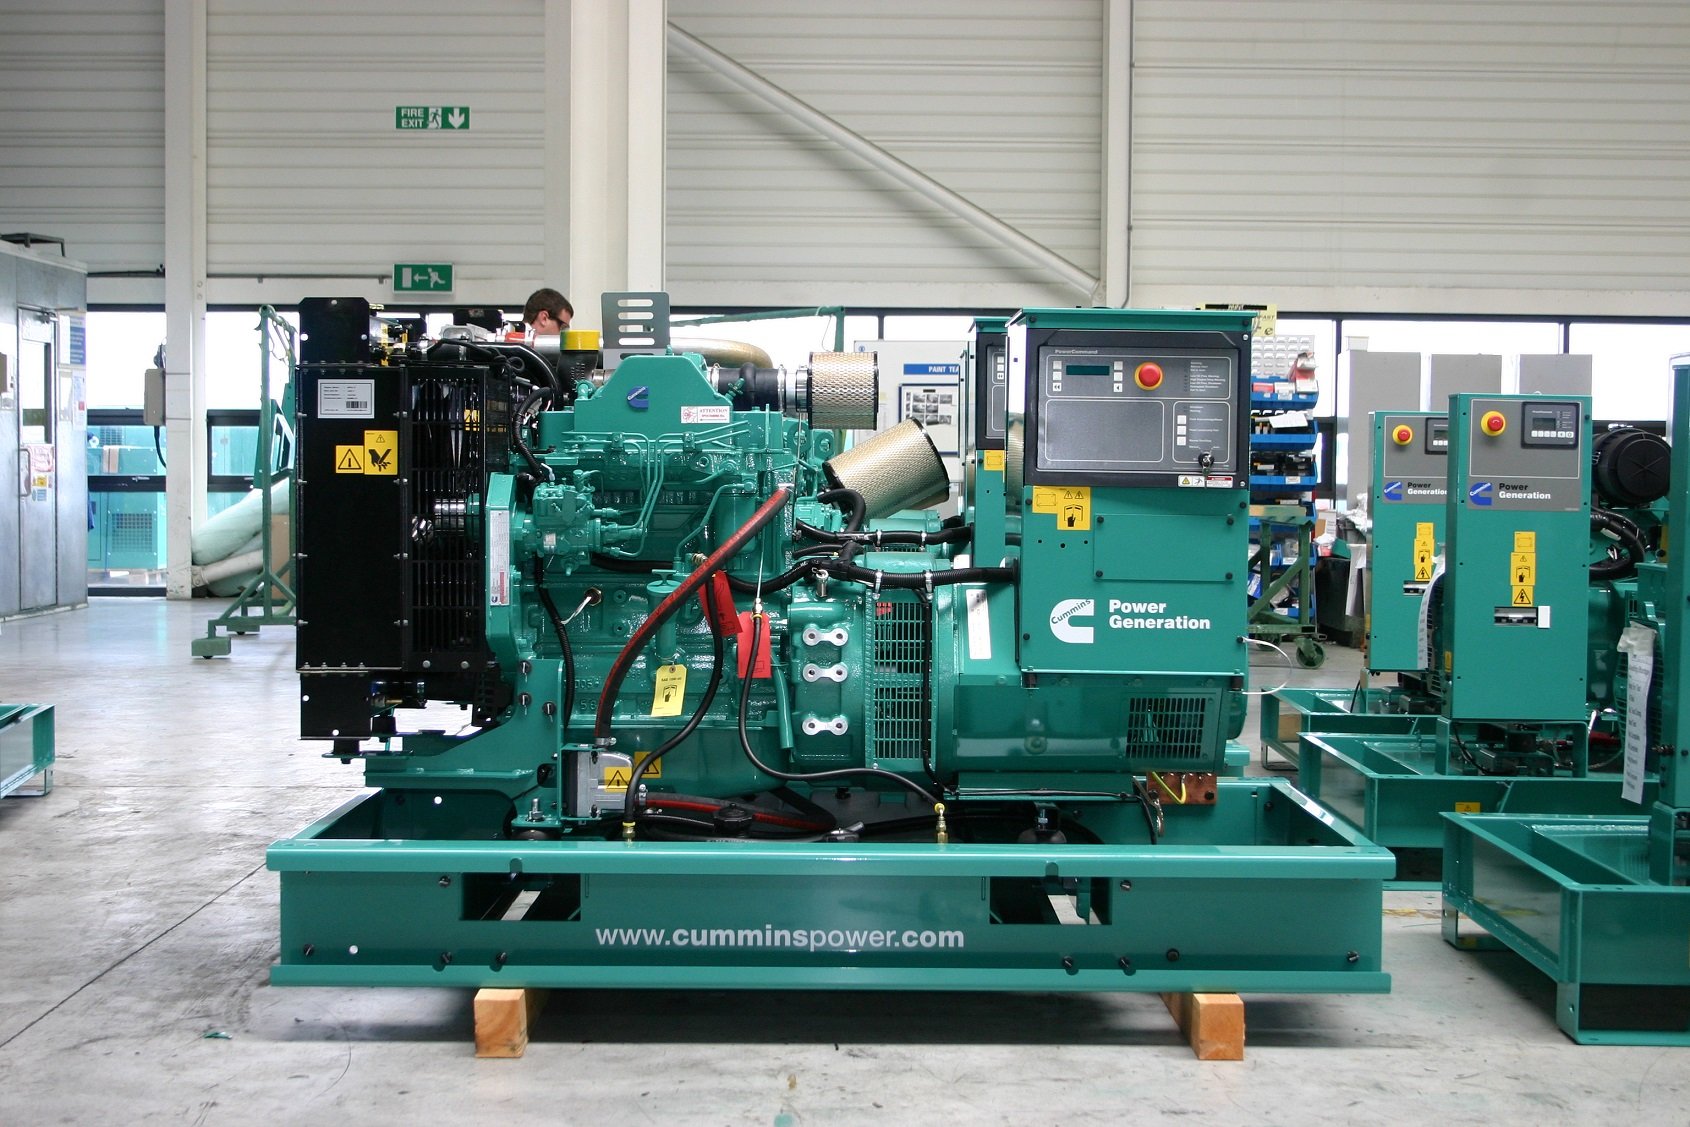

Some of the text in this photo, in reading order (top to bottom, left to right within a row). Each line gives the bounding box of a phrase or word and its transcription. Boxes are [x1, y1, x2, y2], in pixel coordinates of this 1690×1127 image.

[401, 108, 424, 118] FIRE
[401, 119, 424, 128] EXIT
[928, 365, 947, 373] PAINT
[1498, 482, 1529, 491] Power
[1498, 491, 1551, 500] Generation
[1109, 599, 1167, 614] Power
[1051, 599, 1091, 625] Cummins
[1109, 615, 1211, 630] Generation
[595, 924, 964, 952] www.cumminspower.com
